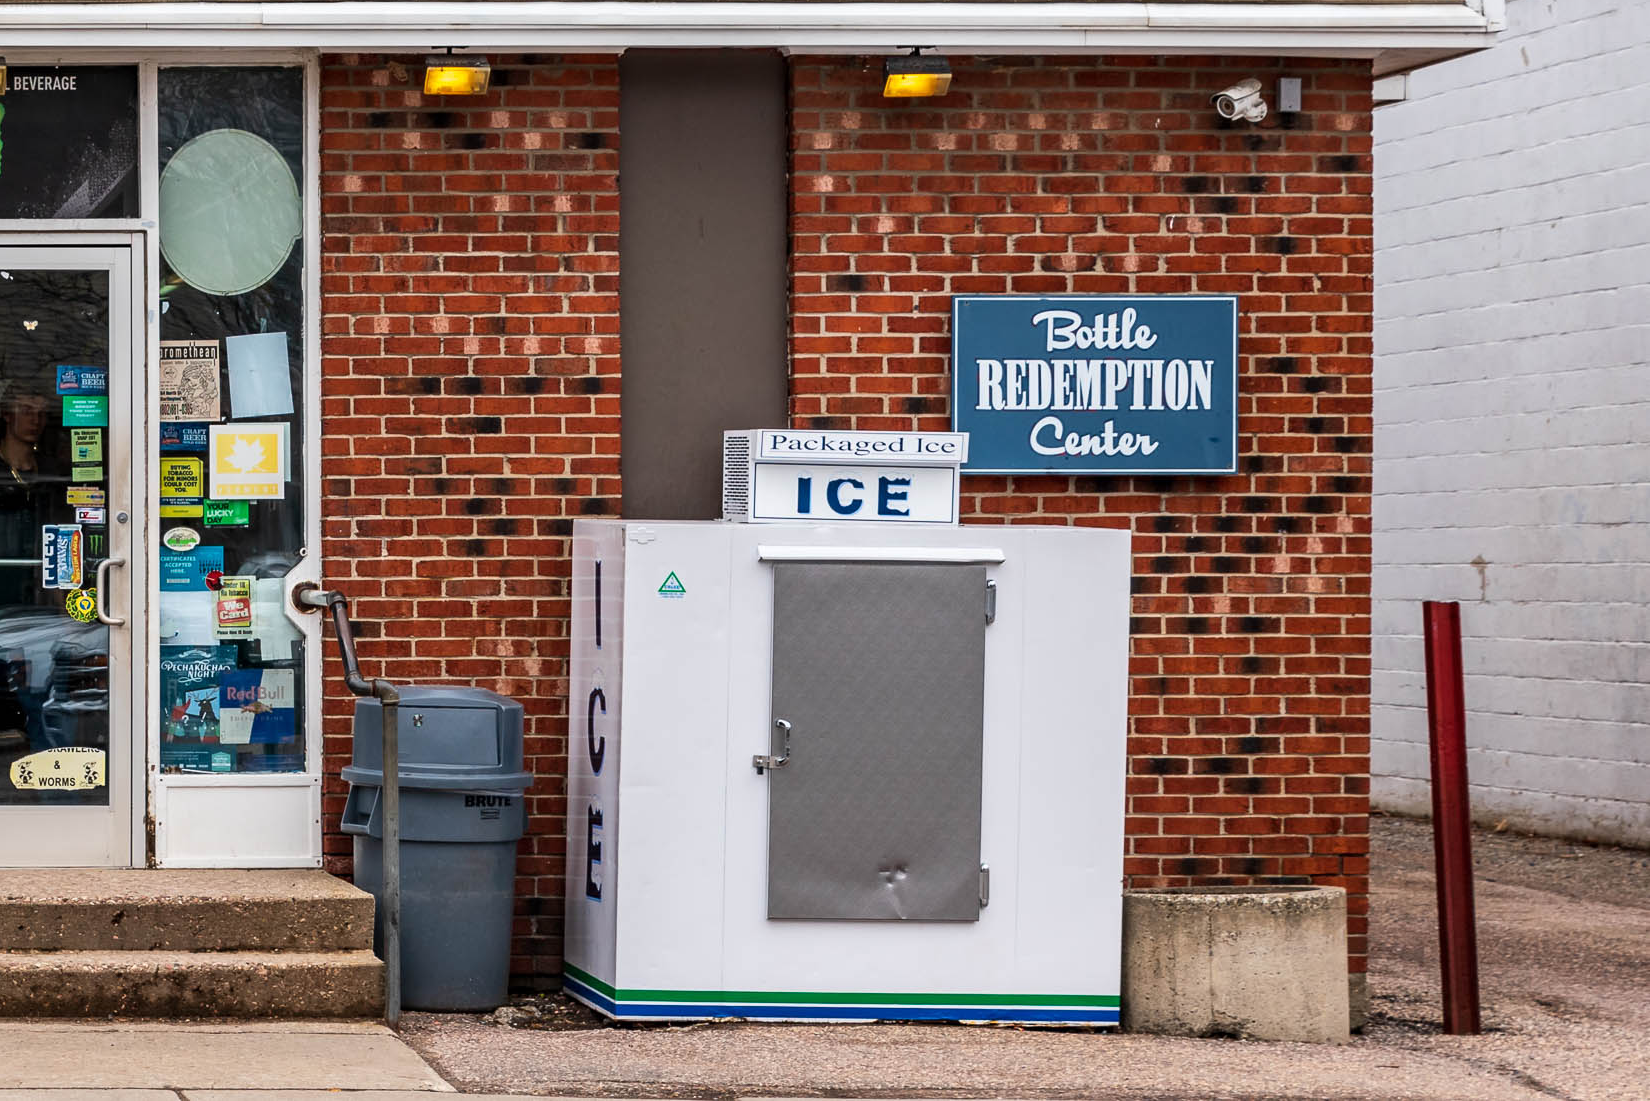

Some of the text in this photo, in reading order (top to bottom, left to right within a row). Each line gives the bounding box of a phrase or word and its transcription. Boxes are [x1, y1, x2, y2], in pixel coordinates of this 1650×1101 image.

[14, 76, 77, 91] BEVERAGE
[1032, 307, 1158, 352] Bottle
[975, 359, 1215, 411] REDEMPTION
[1030, 416, 1159, 456] Center
[770, 434, 956, 455] Packaged Ice
[797, 472, 912, 515] ICE
[207, 509, 234, 517] LUCKY
[44, 533, 55, 580] PULL
[223, 601, 244, 611] We
[220, 609, 249, 620] Card
[161, 660, 230, 672] PECHAKUCHA
[187, 670, 216, 678] NIGHT
[227, 685, 285, 701] Red Bull
[54, 760, 60, 769] &
[38, 778, 76, 787] WORMS
[465, 794, 511, 807] BRUTE
